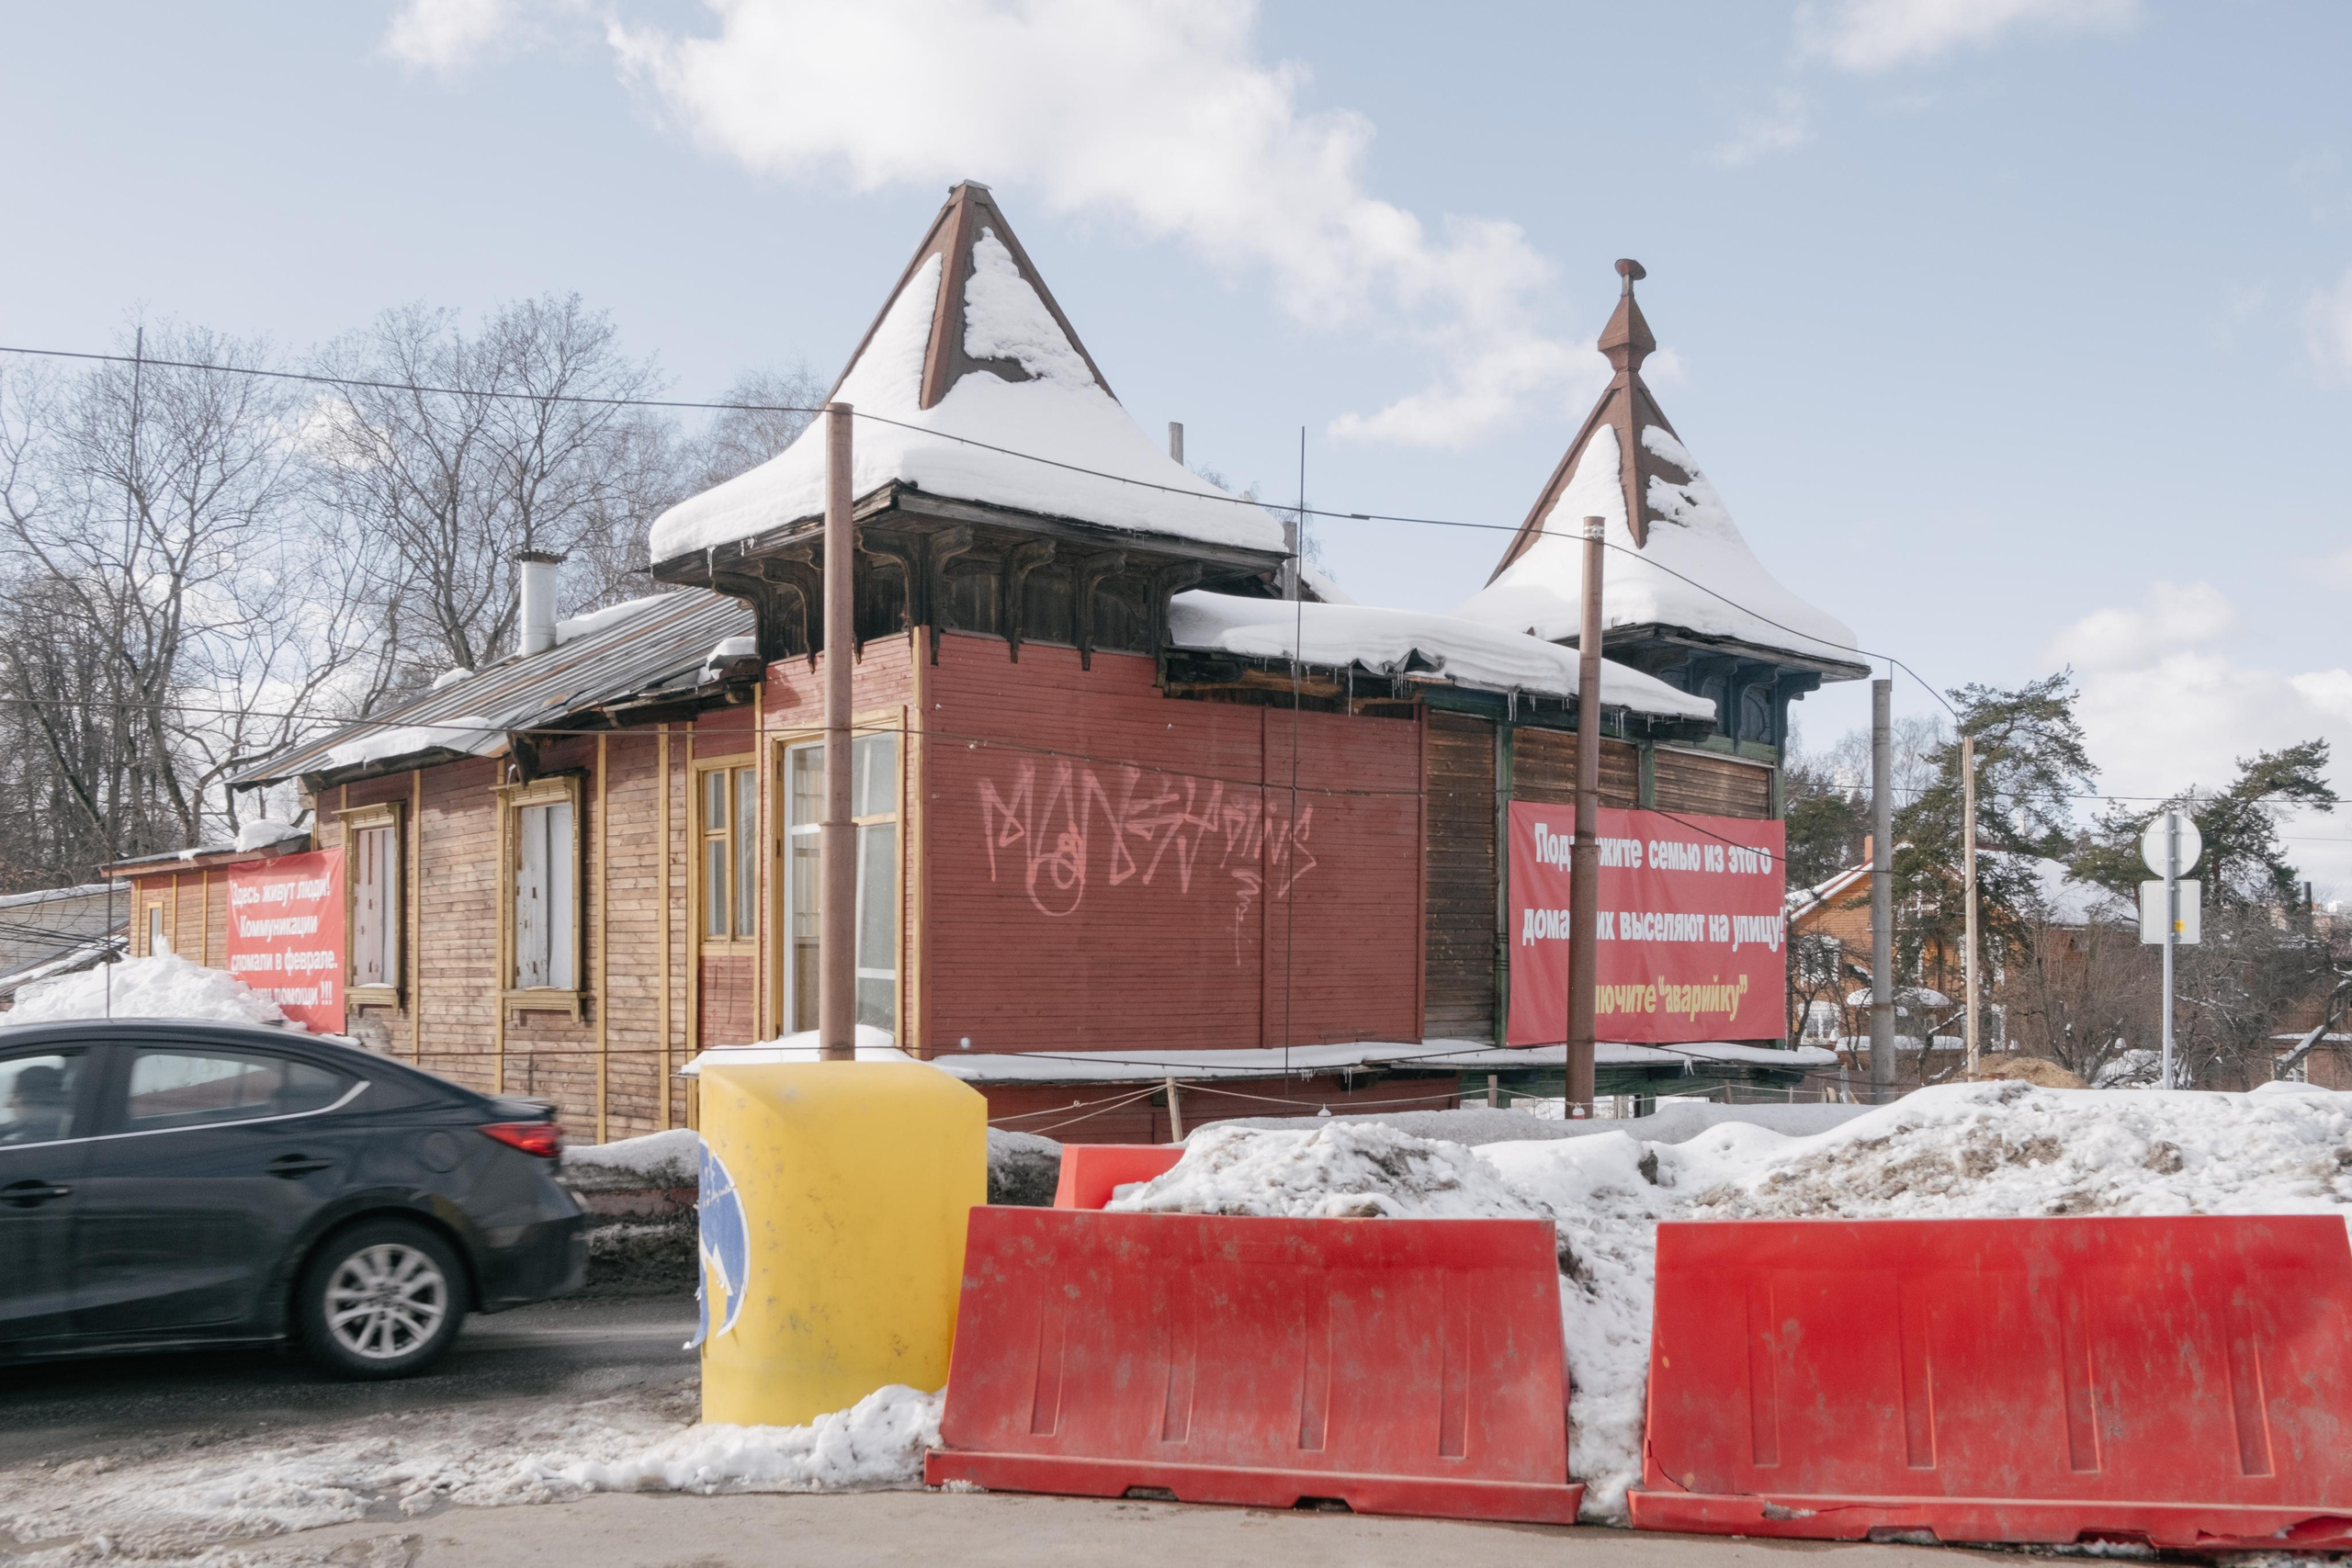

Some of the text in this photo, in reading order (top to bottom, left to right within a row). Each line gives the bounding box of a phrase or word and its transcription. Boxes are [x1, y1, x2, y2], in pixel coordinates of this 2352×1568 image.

[1534, 823, 1772, 874] Поджите семью из этого
[232, 872, 331, 908] Здесь живут люди!
[240, 915, 318, 942] Коммуникации
[1597, 911, 1615, 940] их
[1620, 911, 1705, 942] выселяют
[1709, 914, 1729, 942] на
[1732, 906, 1784, 953] улицу!
[231, 946, 338, 976] сломали в феврале.
[274, 987, 319, 1010] помощи
[1657, 975, 1748, 1022] “аварийку”
